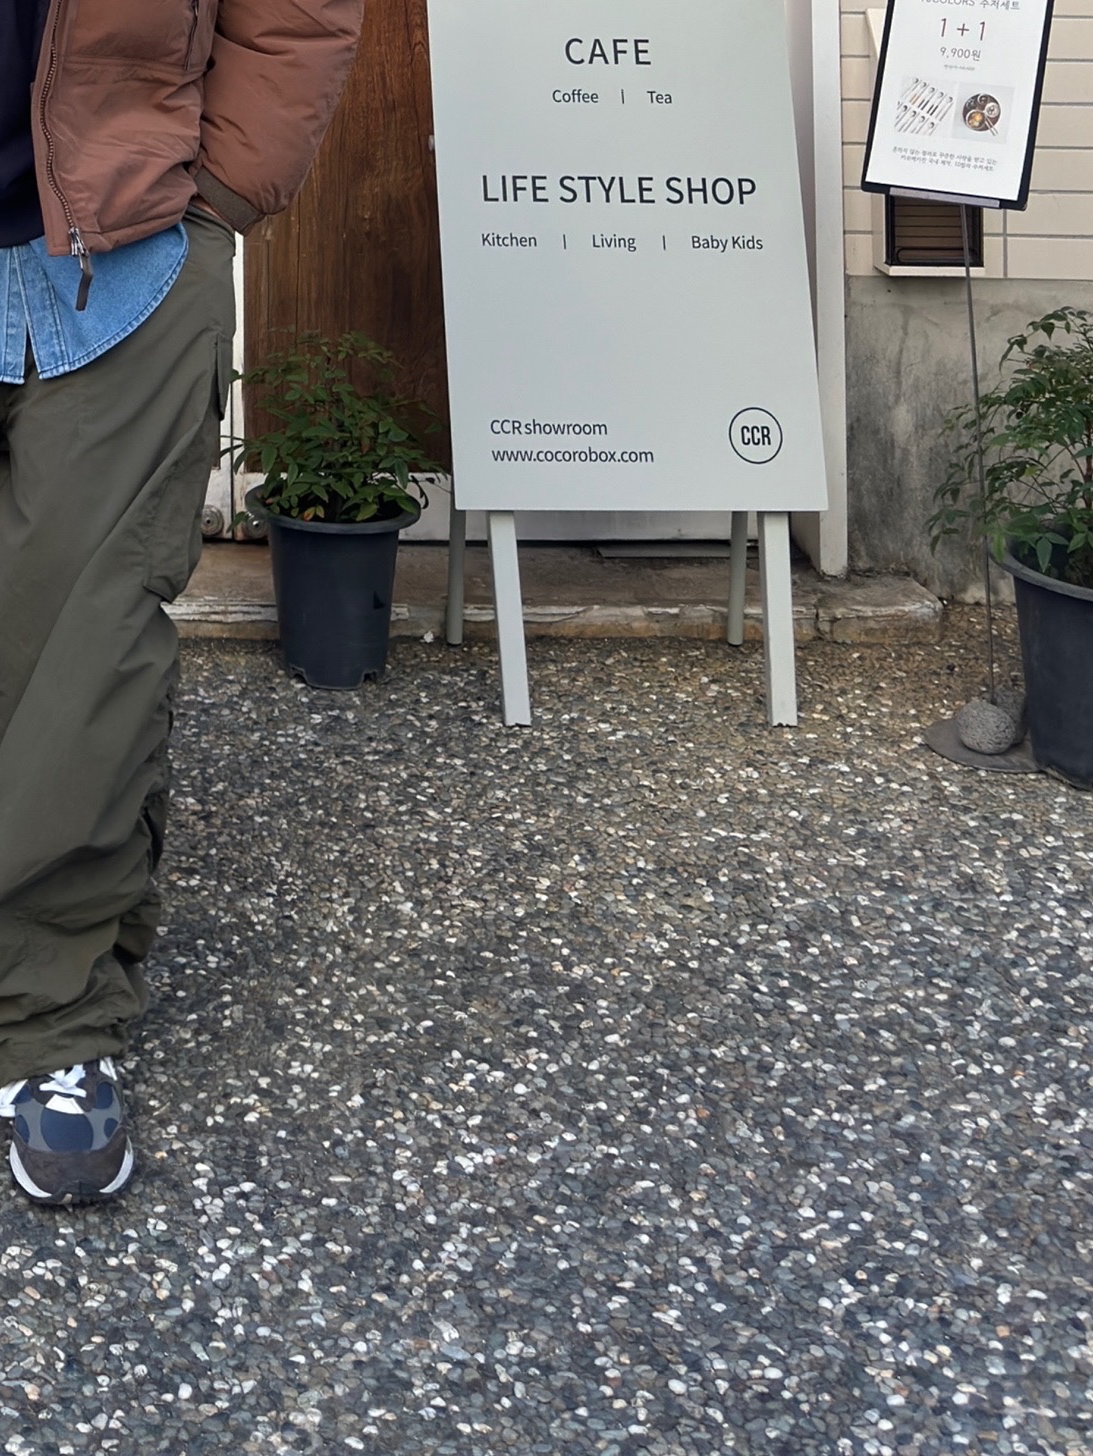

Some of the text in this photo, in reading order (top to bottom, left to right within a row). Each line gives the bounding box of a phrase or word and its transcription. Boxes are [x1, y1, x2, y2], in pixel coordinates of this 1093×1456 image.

[940, 17, 947, 38] 1
[979, 21, 986, 42] 1
[564, 37, 652, 66] CAFE
[551, 88, 673, 105] Coffee Tea
[482, 174, 757, 206] LIFE STYLE SHOP
[481, 232, 764, 254] Kitchen Living Baby Kids
[740, 425, 772, 447] CCR
[491, 445, 655, 464] www.cocorobox.com
